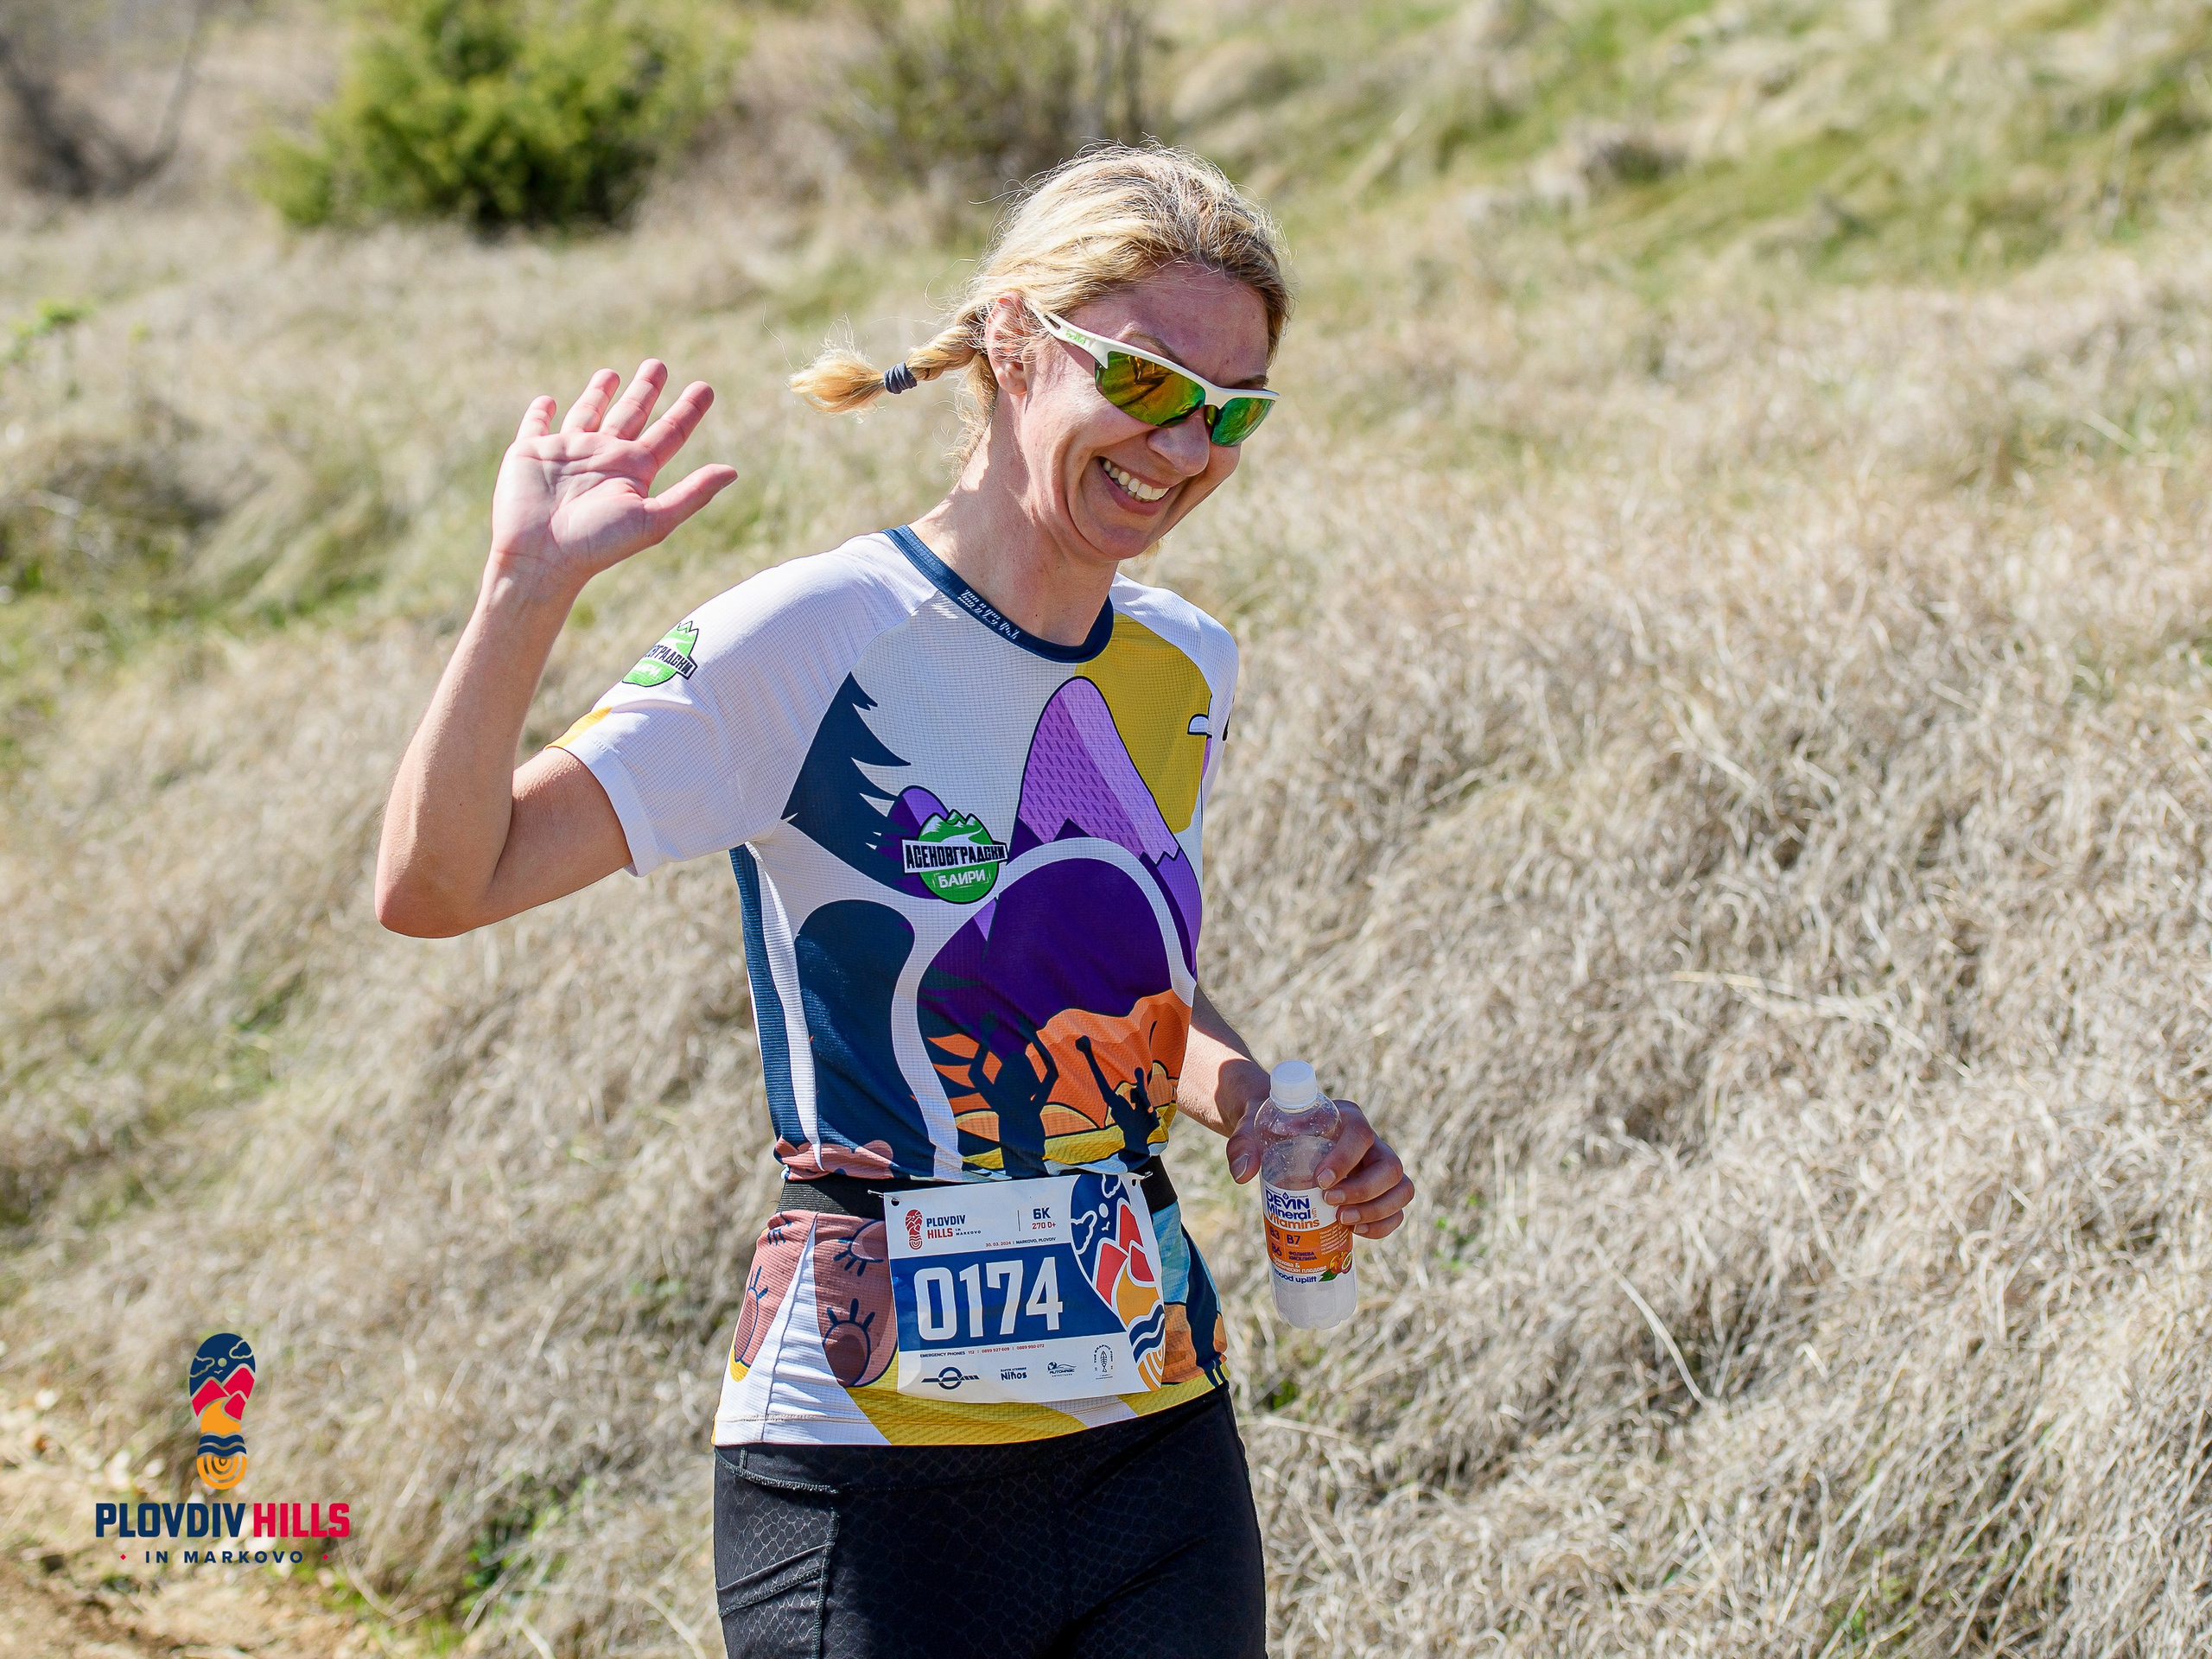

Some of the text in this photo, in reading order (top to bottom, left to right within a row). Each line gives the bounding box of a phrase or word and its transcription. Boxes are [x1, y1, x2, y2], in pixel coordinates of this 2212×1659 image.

[938, 868, 986, 888] БАИРИ
[1265, 1188, 1310, 1210] DEVIN
[1033, 1207, 1051, 1220] 6K
[1267, 1200, 1312, 1220] Mineral
[926, 1214, 966, 1227] PLOVDIV
[1032, 1222, 1046, 1230] 270
[1268, 1210, 1320, 1229] Vitamins
[927, 1227, 953, 1239] HILLS
[1269, 1227, 1281, 1240] B3
[1287, 1234, 1301, 1245] B7
[1274, 1268, 1317, 1284] mood uplift
[913, 1256, 1064, 1341] 0174
